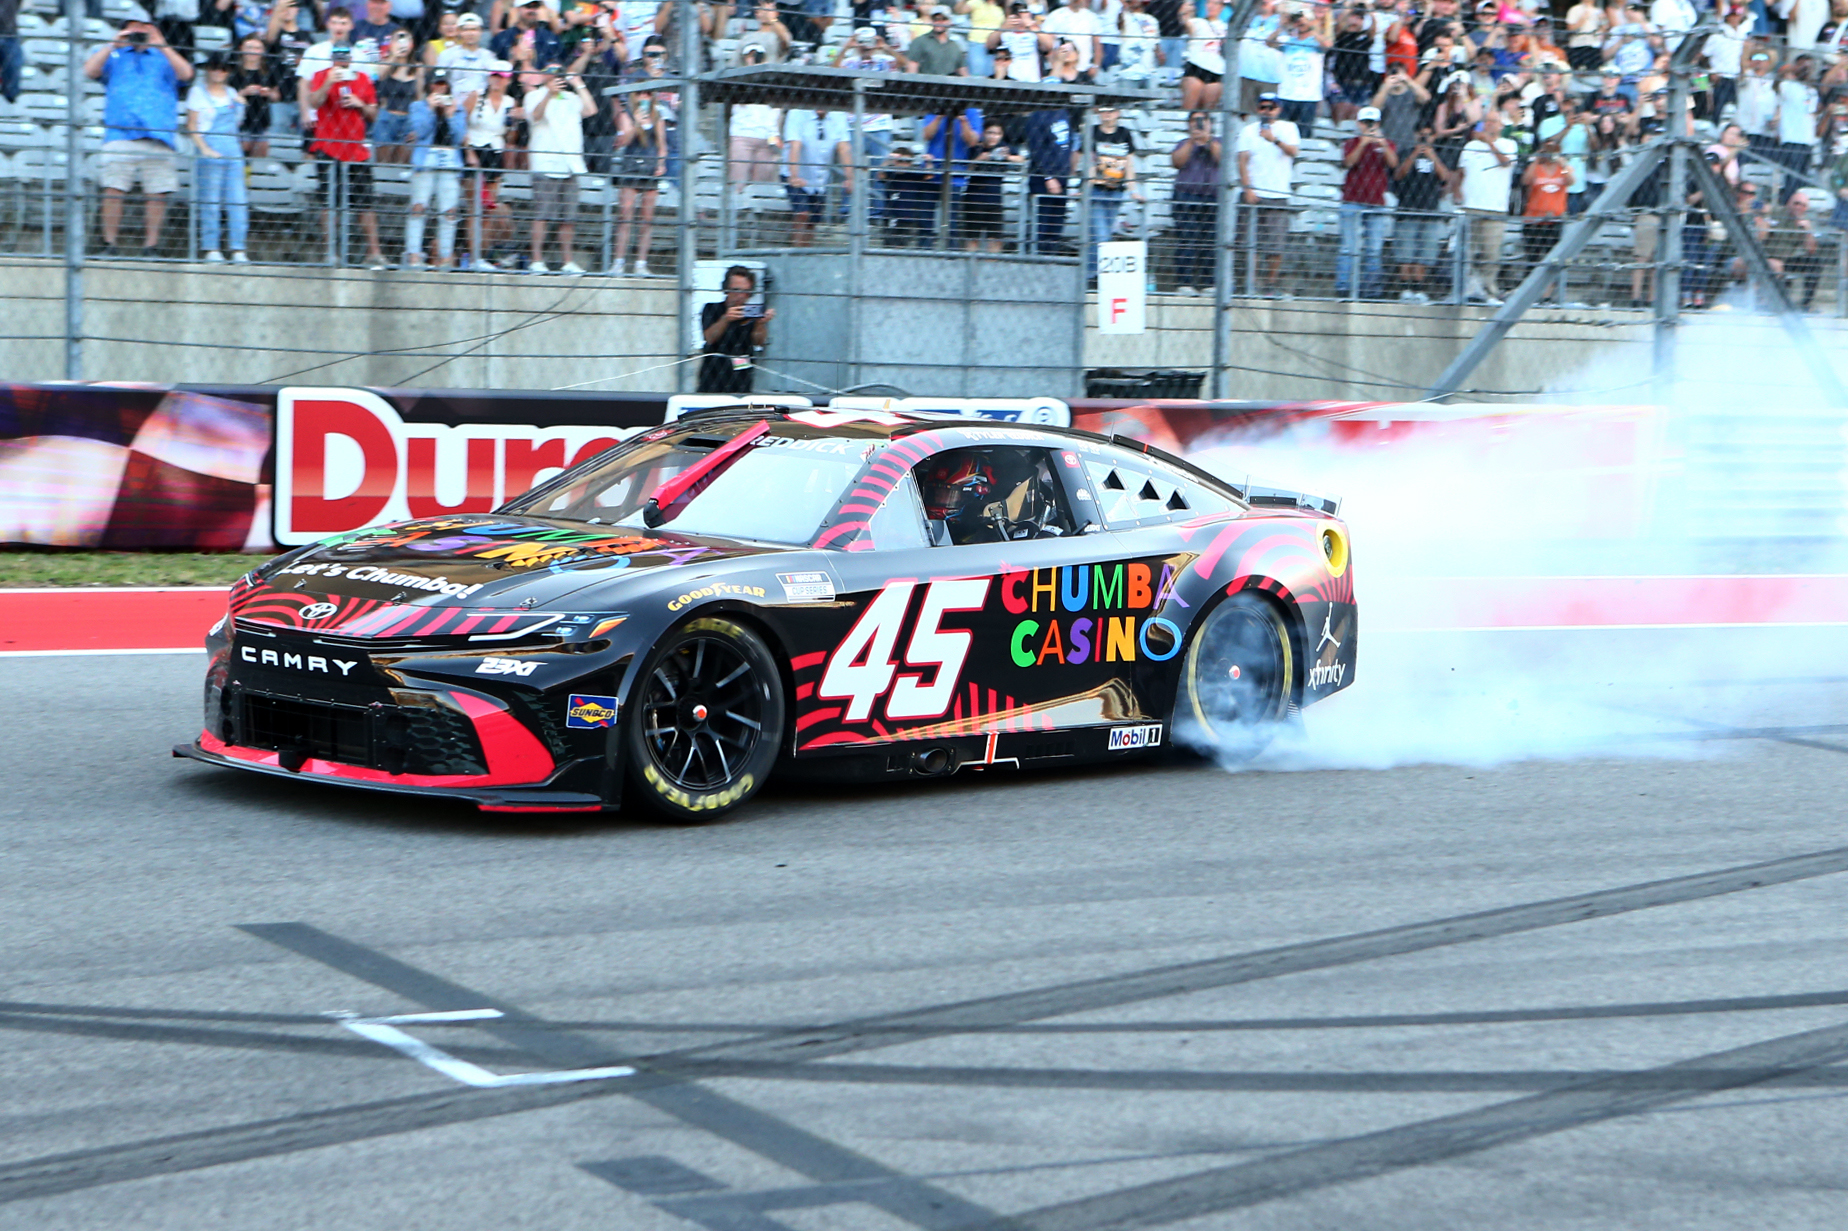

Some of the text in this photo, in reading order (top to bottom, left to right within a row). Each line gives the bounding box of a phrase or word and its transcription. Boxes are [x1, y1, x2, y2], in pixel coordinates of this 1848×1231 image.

[1111, 298, 1128, 324] F
[345, 566, 485, 600] Chumba!
[792, 585, 828, 595] CUP SERIES
[795, 573, 823, 582] NASCAR
[998, 561, 1190, 615] CHUMBA
[667, 582, 766, 611] GOODYEAR
[817, 576, 994, 724] 45
[1010, 616, 1183, 668] CASINO
[241, 646, 358, 676] CAMRY
[1307, 658, 1347, 691] xfinity
[571, 708, 615, 718] SUNOCO
[1110, 727, 1158, 747] Mobil 1
